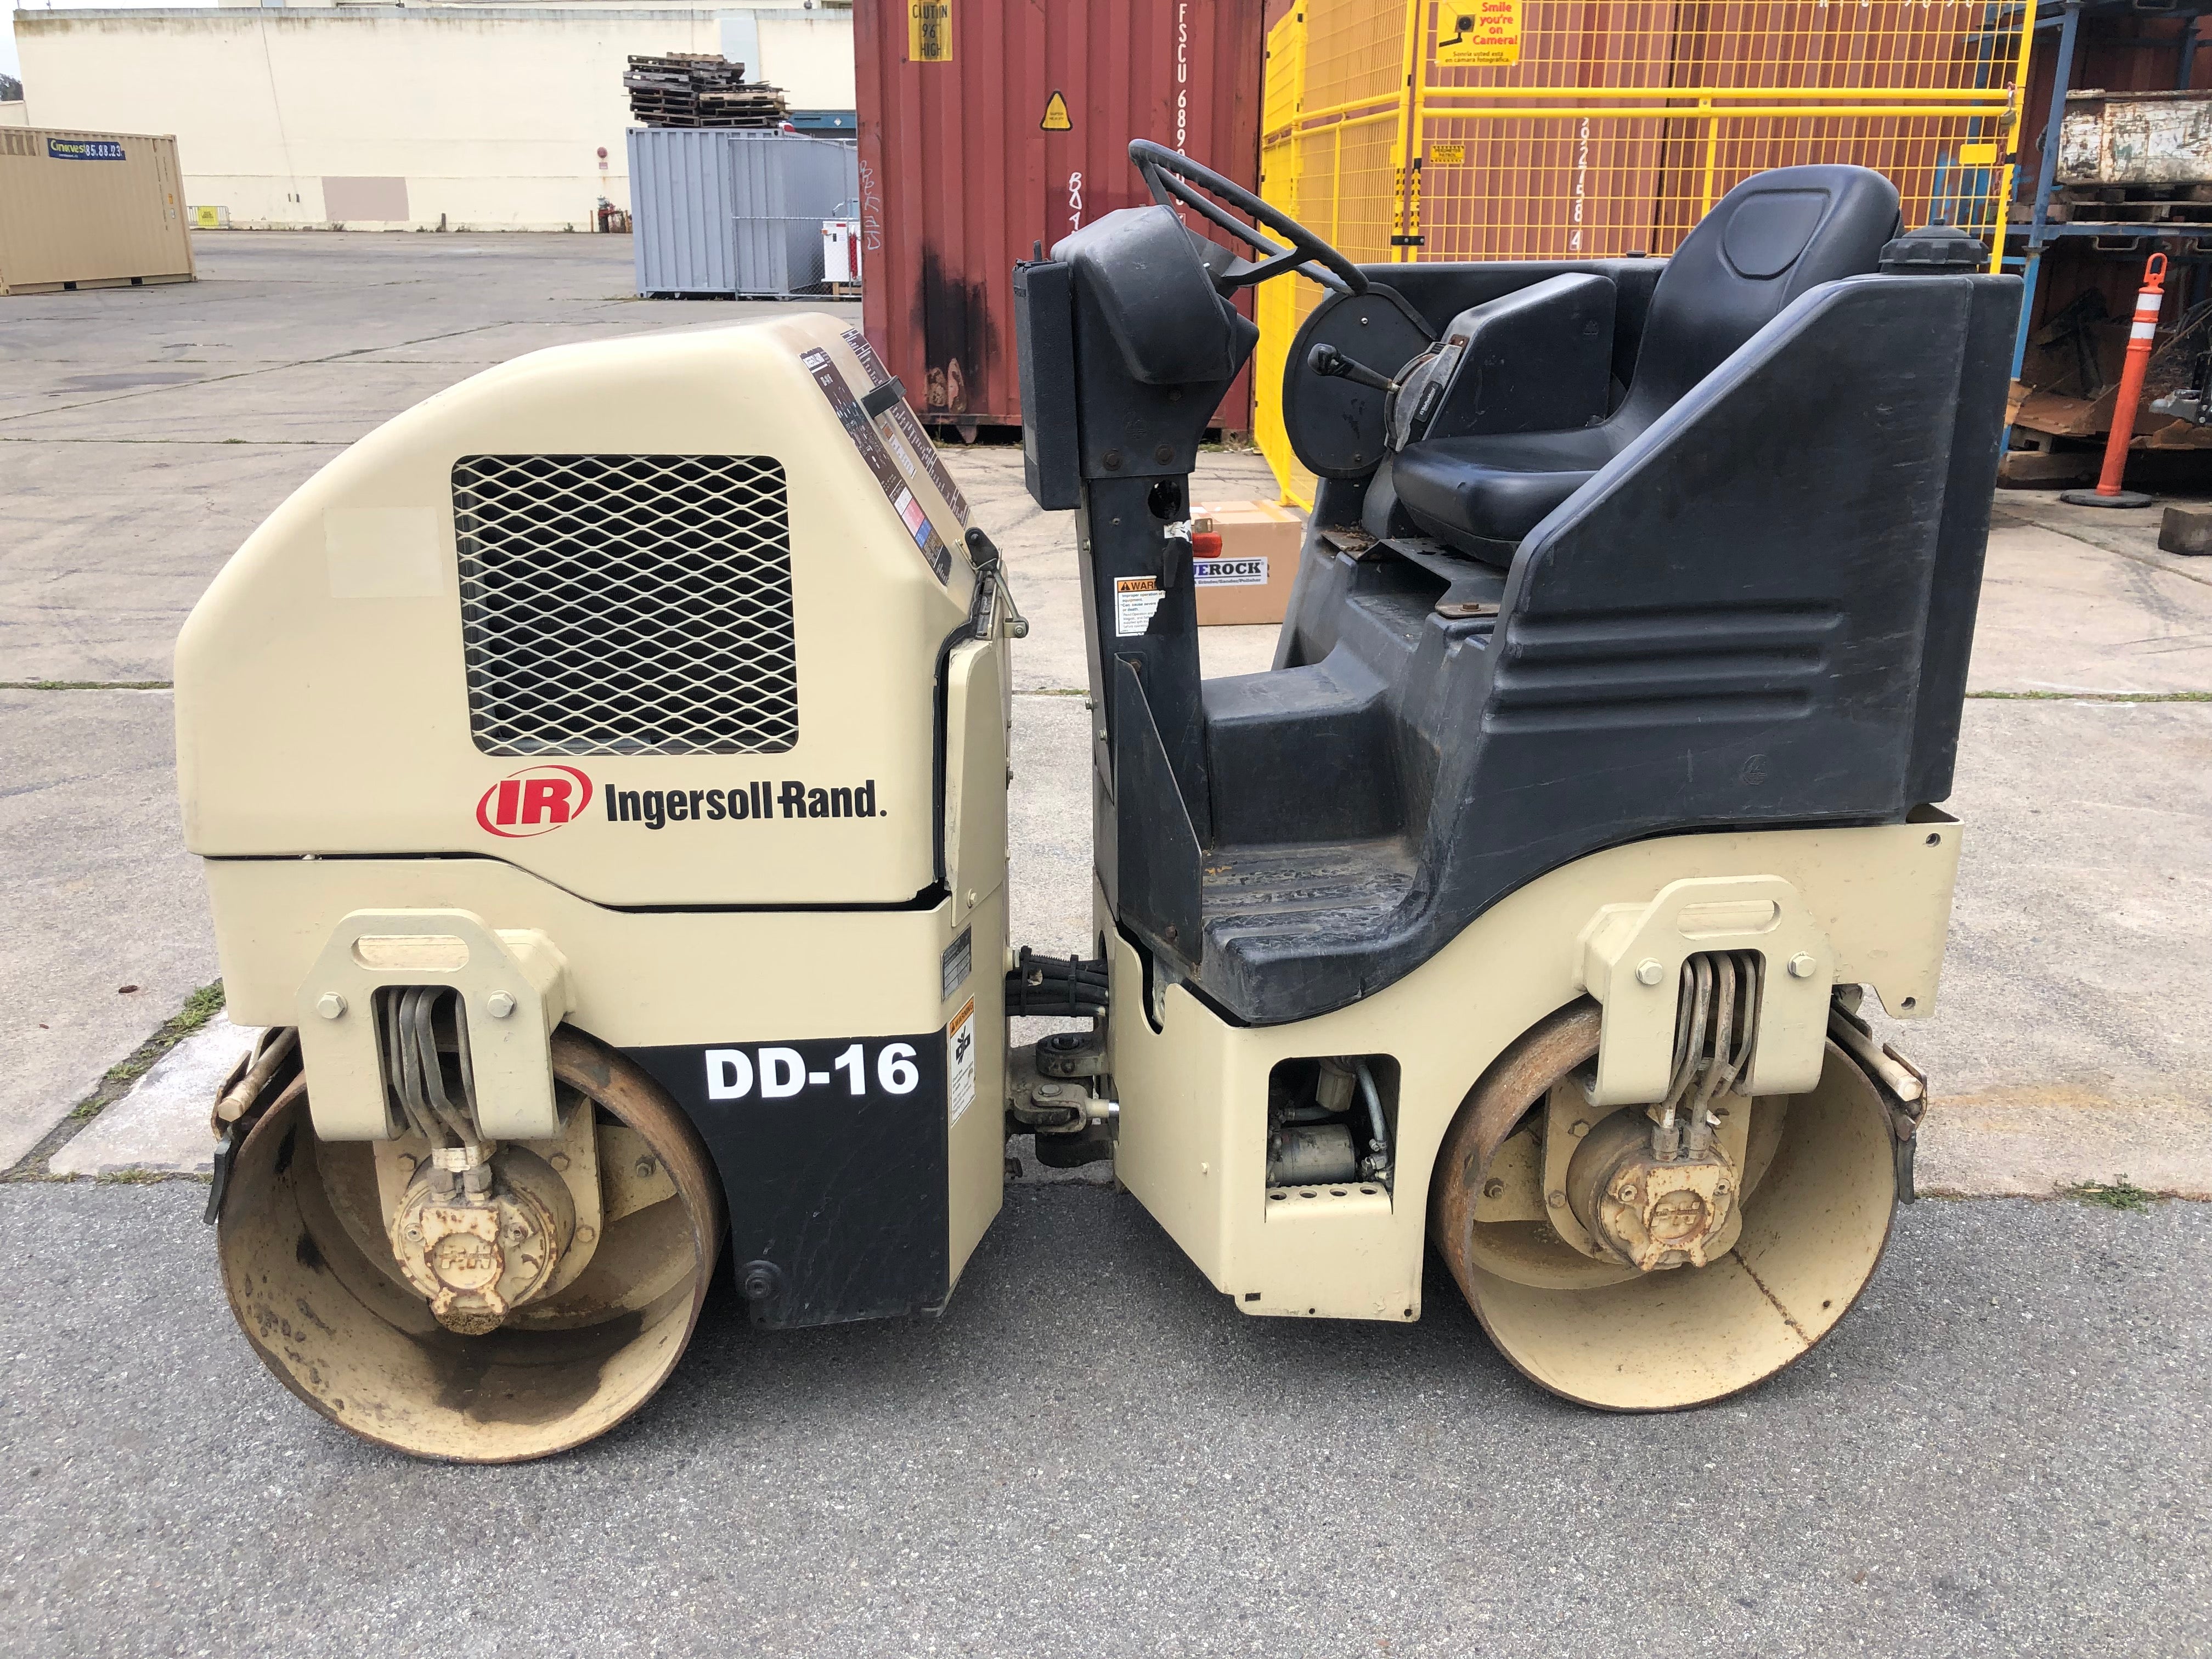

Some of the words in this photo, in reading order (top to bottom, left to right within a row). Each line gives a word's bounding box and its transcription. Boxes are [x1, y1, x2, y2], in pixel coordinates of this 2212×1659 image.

[1482, 2, 1512, 12] Smile
[1480, 14, 1513, 26] you're
[1178, 3, 1188, 83] FSCU
[1473, 35, 1517, 45] Camera!
[704, 1042, 919, 1100] DD-16
